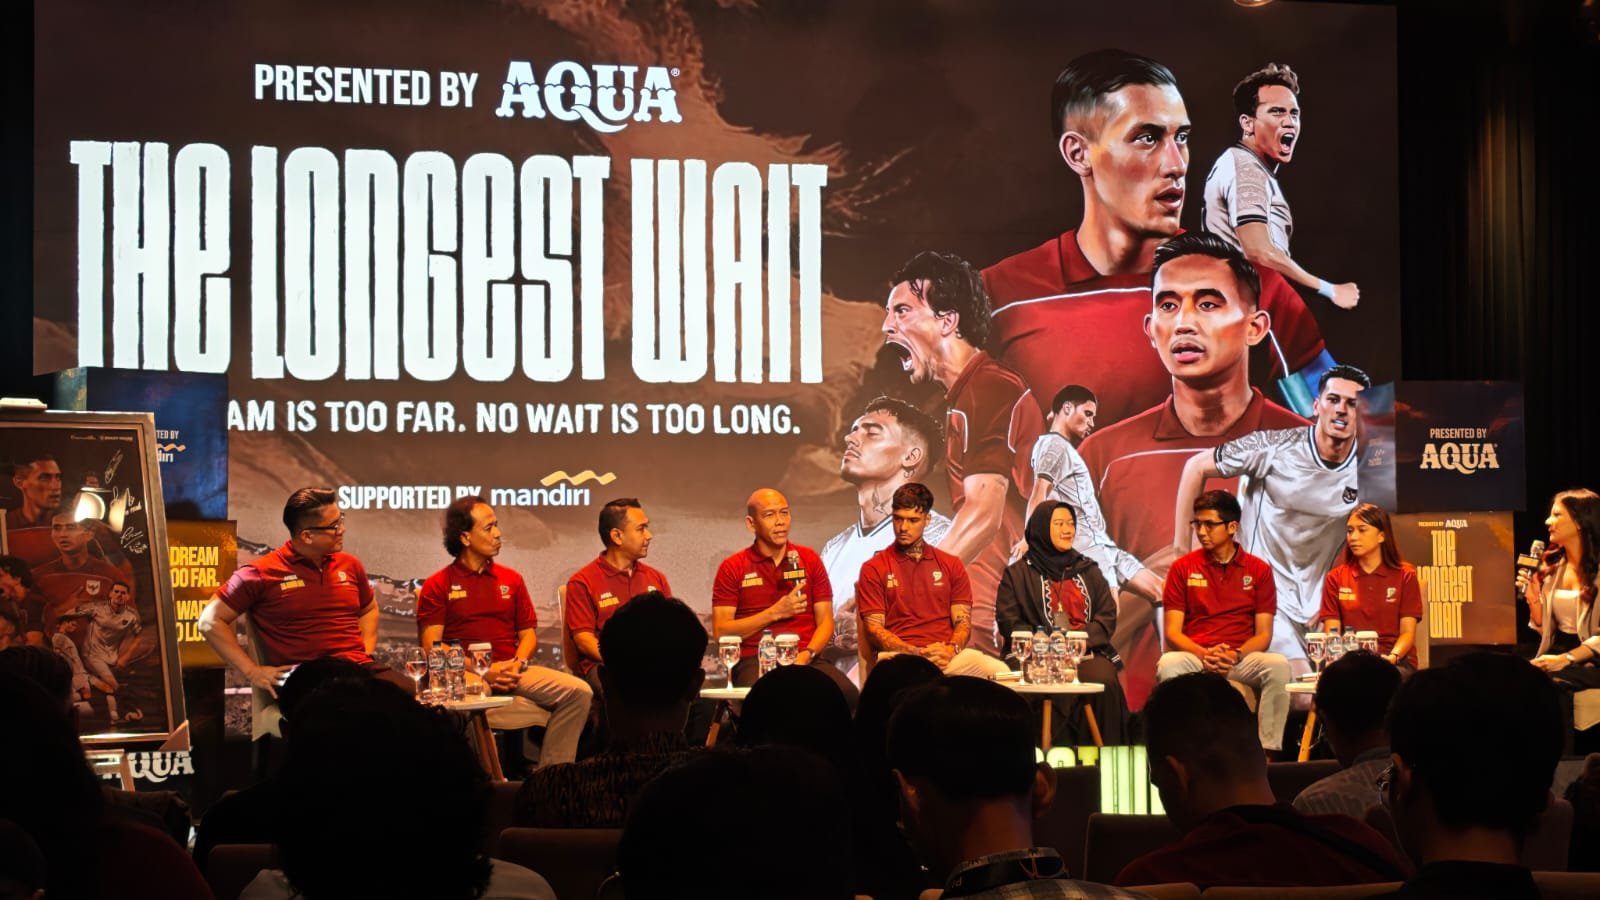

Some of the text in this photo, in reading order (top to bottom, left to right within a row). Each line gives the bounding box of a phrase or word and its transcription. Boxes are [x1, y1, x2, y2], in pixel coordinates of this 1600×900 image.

[254, 63, 431, 106] PRESENTED
[440, 72, 479, 108] BY
[630, 158, 829, 384] WAIT
[286, 400, 317, 433] IS
[324, 400, 388, 433] TOO
[396, 400, 466, 433] FAR.
[476, 402, 519, 434] NO
[525, 403, 604, 434] WAIT
[611, 402, 639, 434] IS
[645, 403, 705, 434] TOO
[712, 403, 801, 435] LONG.
[1429, 428, 1488, 439] PRESENTED BY
[337, 485, 452, 510] SUPPORTED
[490, 483, 590, 506] mandiri
[169, 546, 219, 566] DREAM
[190, 568, 220, 588] FAR.
[1429, 601, 1463, 638] WAIT
